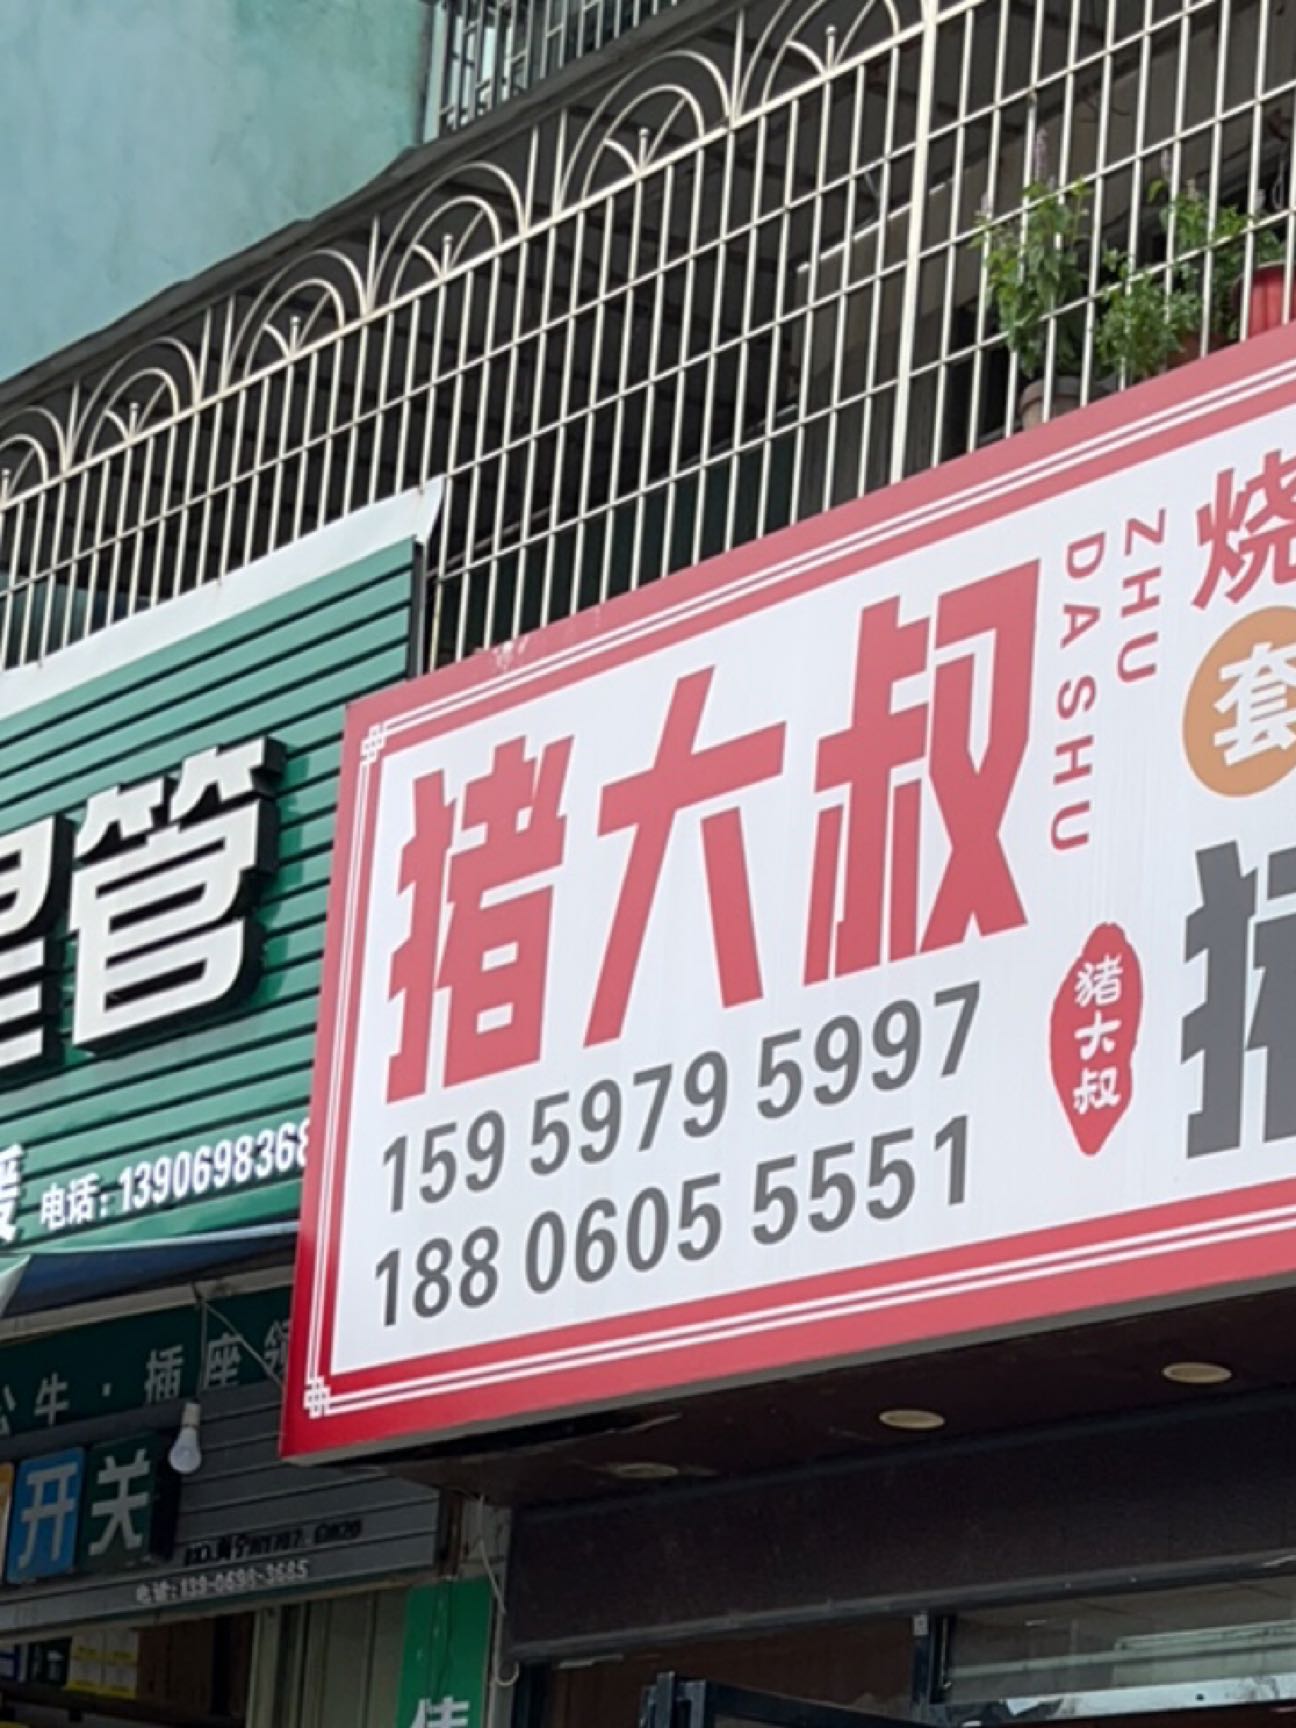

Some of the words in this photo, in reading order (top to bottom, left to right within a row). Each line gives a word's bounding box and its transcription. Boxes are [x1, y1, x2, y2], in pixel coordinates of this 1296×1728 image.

[1116, 507, 1167, 684] ZHU
[386, 559, 1042, 1104] 猪大叔
[384, 1109, 507, 1214] 159
[530, 1050, 729, 1180] 5979
[756, 981, 981, 1120] 5997
[1073, 953, 1124, 1116] 猪大叔
[375, 1223, 499, 1327] 188
[524, 1173, 723, 1296] 0605
[751, 1114, 970, 1246] 5551
[18, 1447, 152, 1569] 开关
